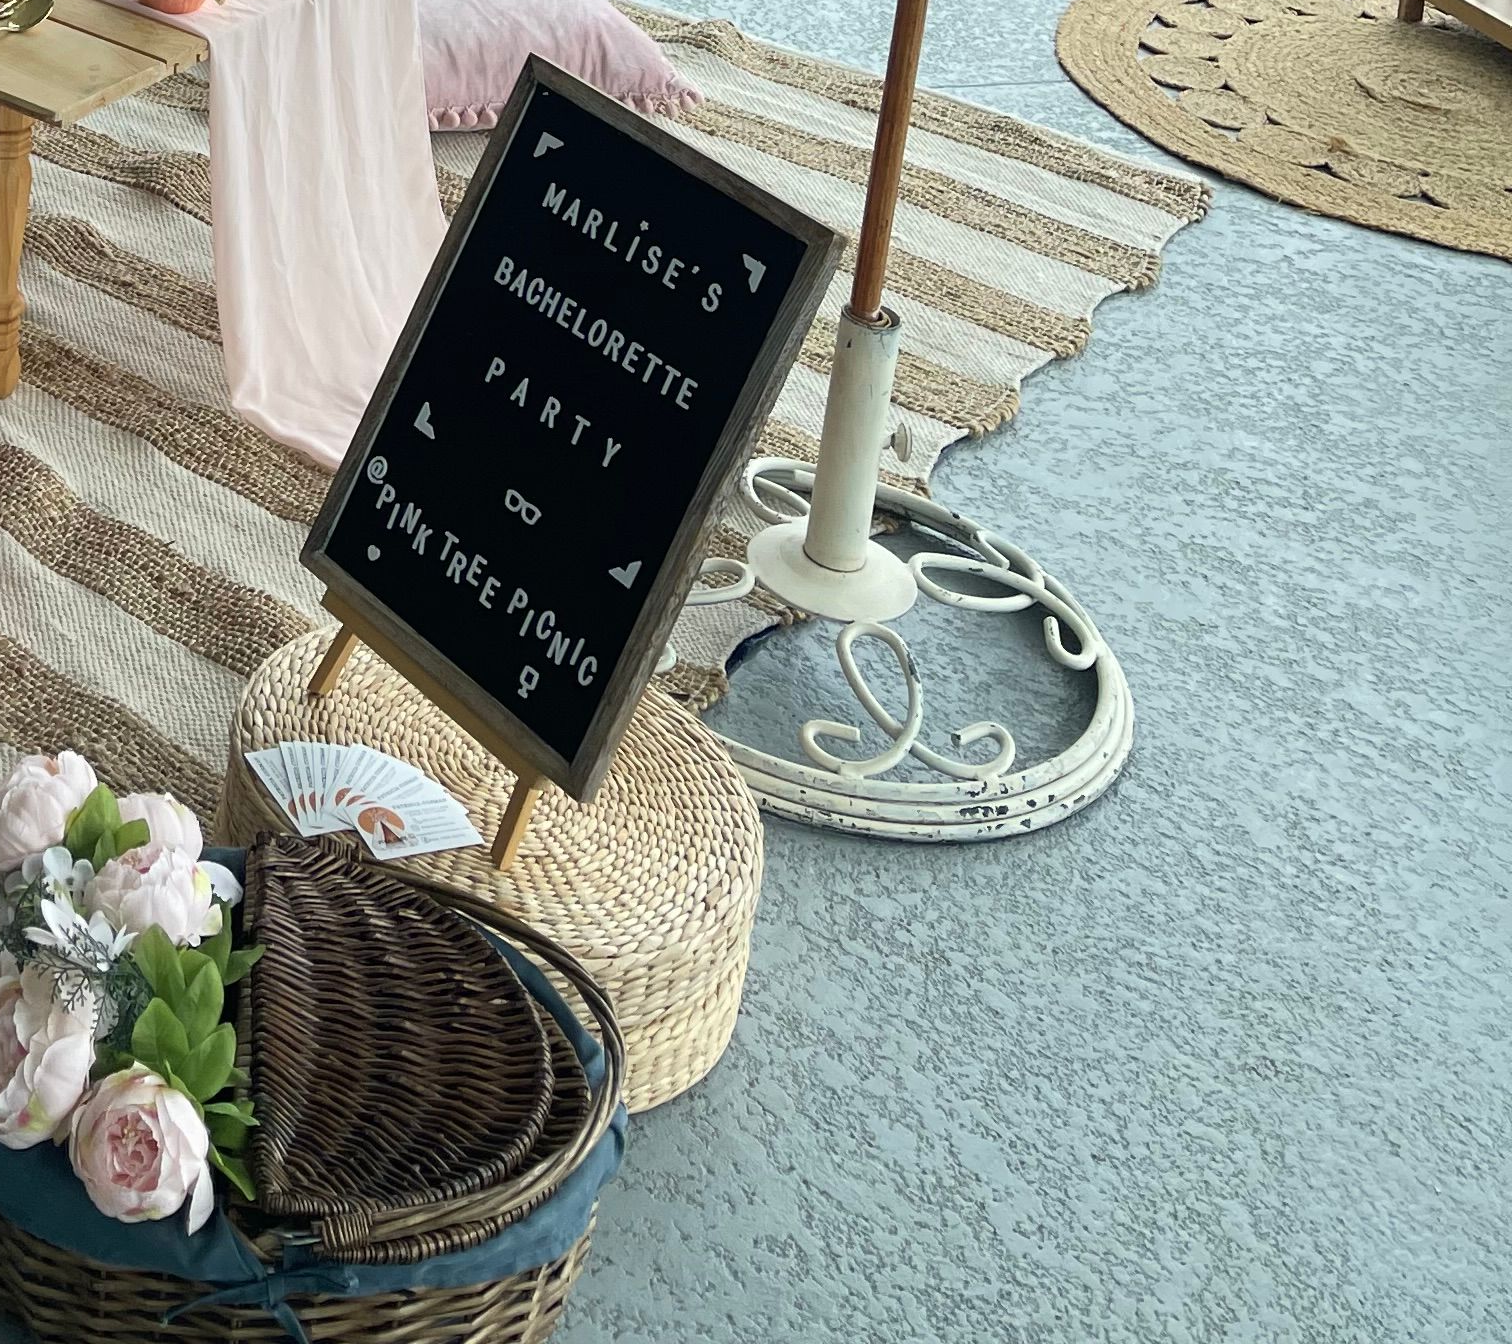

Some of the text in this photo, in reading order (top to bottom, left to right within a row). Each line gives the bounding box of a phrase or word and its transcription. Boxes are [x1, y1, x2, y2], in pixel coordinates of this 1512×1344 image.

[493, 256, 699, 410] BACHELORETTE
[484, 357, 622, 468] PARTY
[366, 455, 598, 687] @PINK TREE PICNIC
